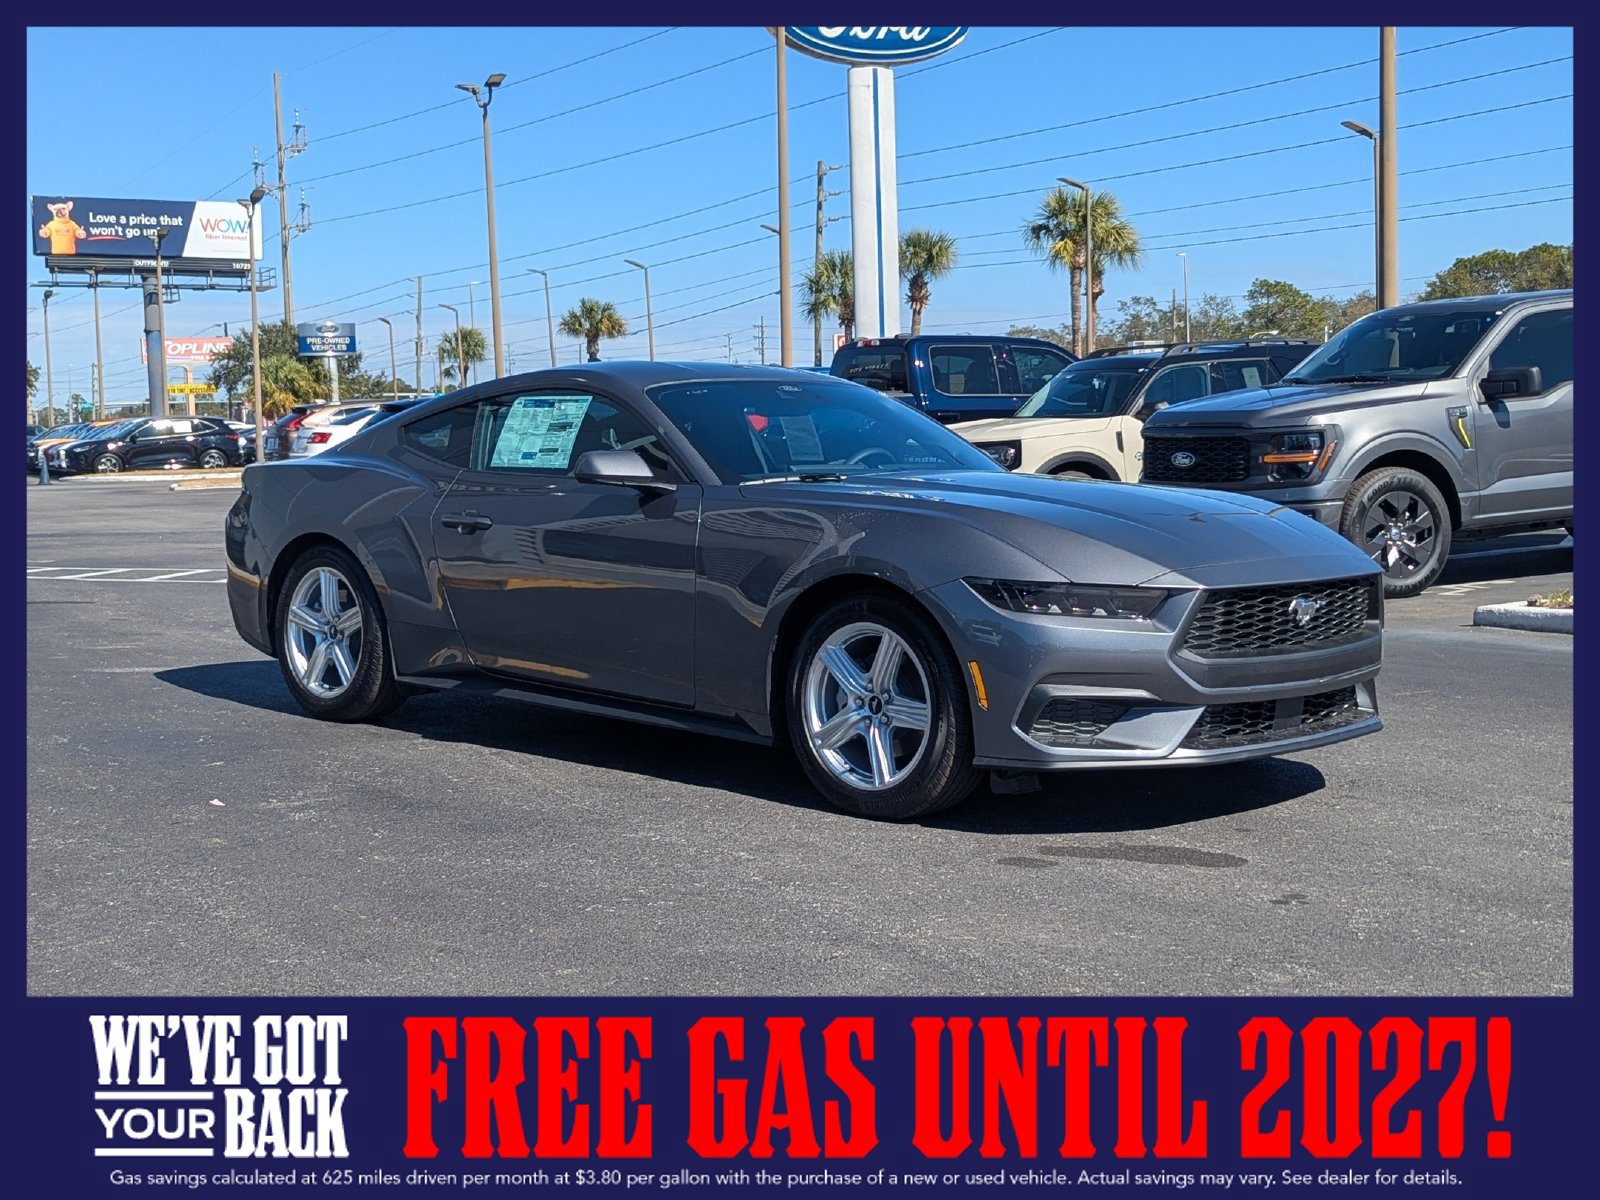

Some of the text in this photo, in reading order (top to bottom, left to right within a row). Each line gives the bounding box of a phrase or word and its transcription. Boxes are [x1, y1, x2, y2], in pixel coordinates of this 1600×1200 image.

[89, 212, 183, 226] Love a price that
[90, 225, 123, 236] won't
[126, 227, 141, 239] go
[306, 337, 350, 345] PRE-OWNED
[1174, 453, 1191, 465] Ford
